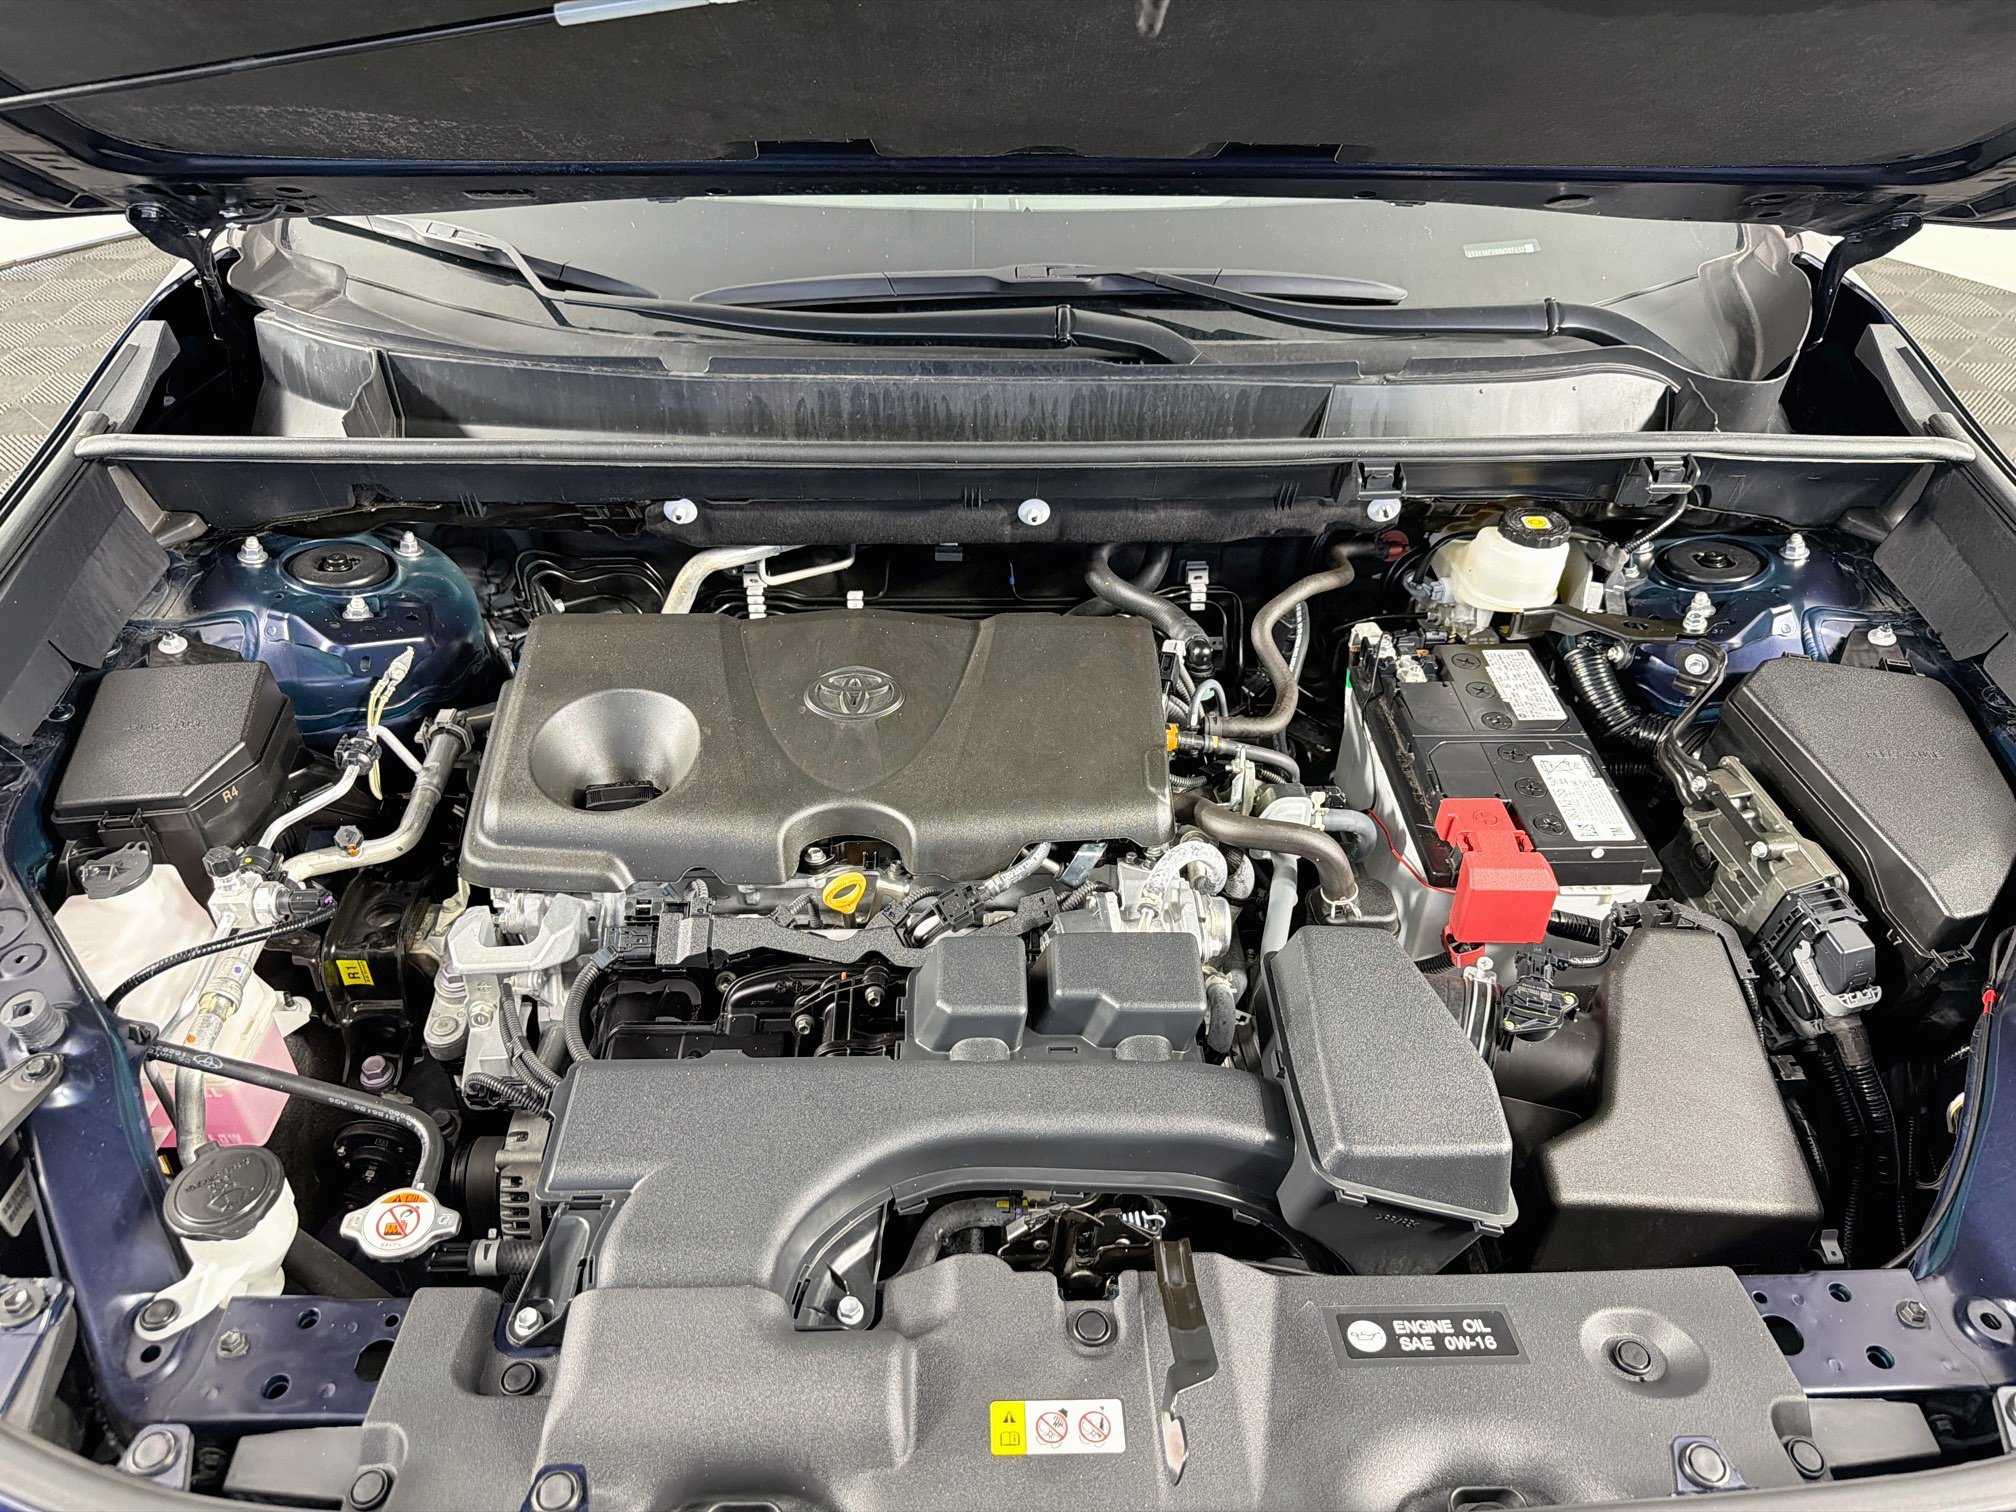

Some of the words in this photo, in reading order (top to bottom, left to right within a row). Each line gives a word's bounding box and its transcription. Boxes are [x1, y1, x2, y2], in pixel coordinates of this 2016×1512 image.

[221, 785, 239, 804] R4
[1886, 928, 1903, 946] L7
[345, 965, 361, 980] R1
[1392, 1319, 1455, 1335] ENGINE
[1462, 1318, 1492, 1334] OIL
[1399, 1336, 1436, 1352] SAE
[1444, 1335, 1498, 1351] 0W-16
